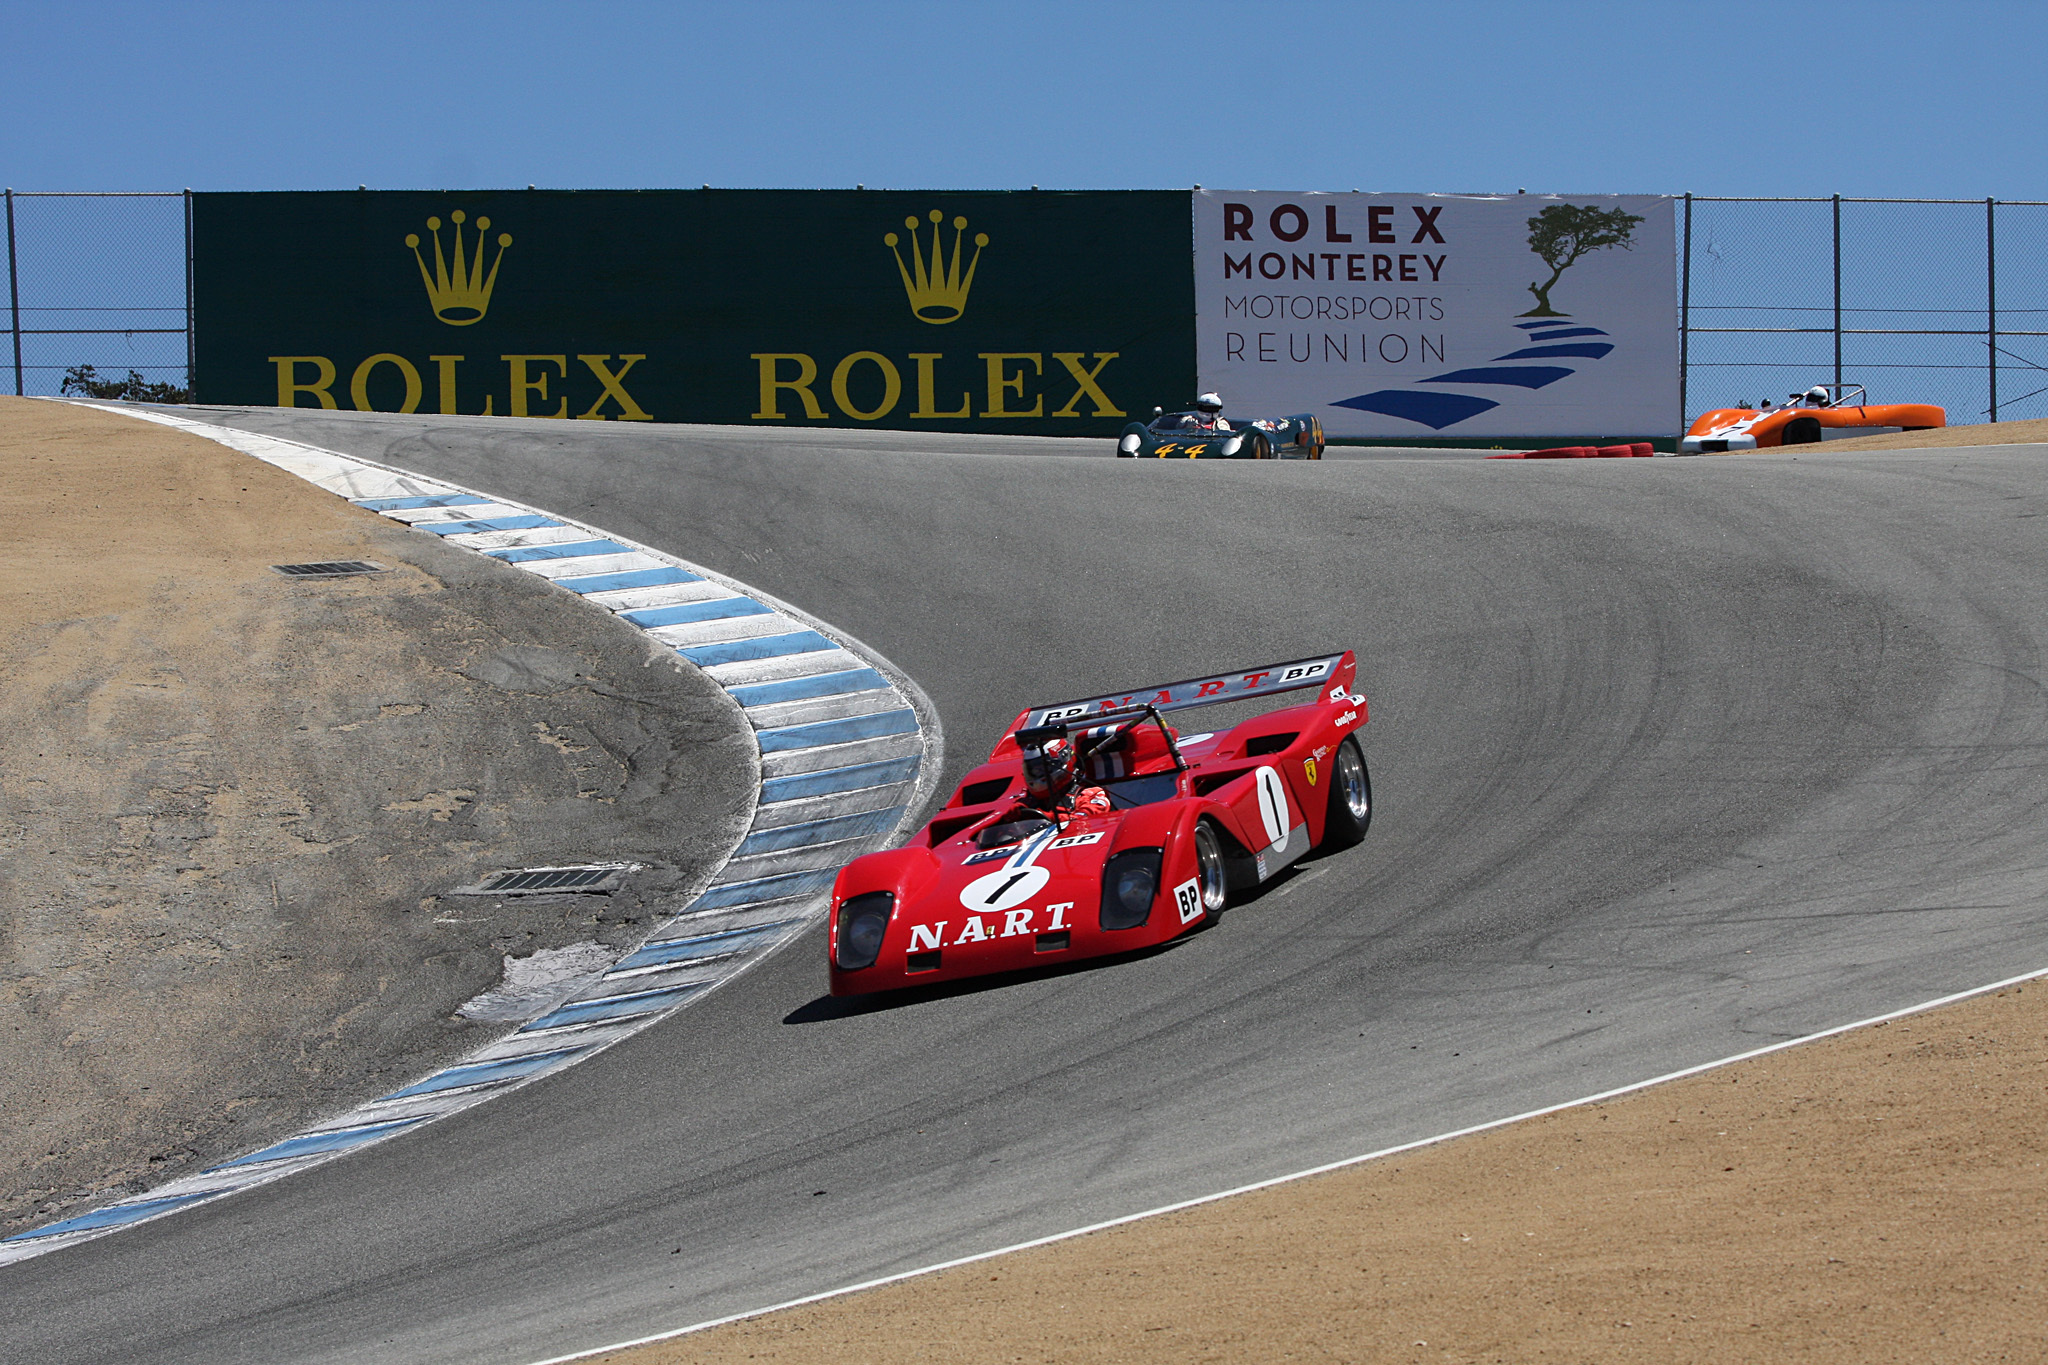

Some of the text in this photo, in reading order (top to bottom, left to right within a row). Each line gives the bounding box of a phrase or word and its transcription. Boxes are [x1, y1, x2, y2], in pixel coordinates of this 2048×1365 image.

[1224, 203, 1446, 244] ROLEX
[1224, 252, 1447, 282] MONTEREY
[1225, 294, 1445, 321] MOTORSPORTS
[1227, 332, 1445, 364] REUNION
[269, 353, 654, 421] ROLEX
[751, 351, 1127, 420] ROLEX
[1284, 664, 1325, 680] BP
[1265, 774, 1283, 836] 1
[1055, 834, 1097, 847] BP
[984, 872, 1031, 904] 1
[1179, 885, 1198, 917] BP
[905, 902, 1074, 953] N.A.R.T.
